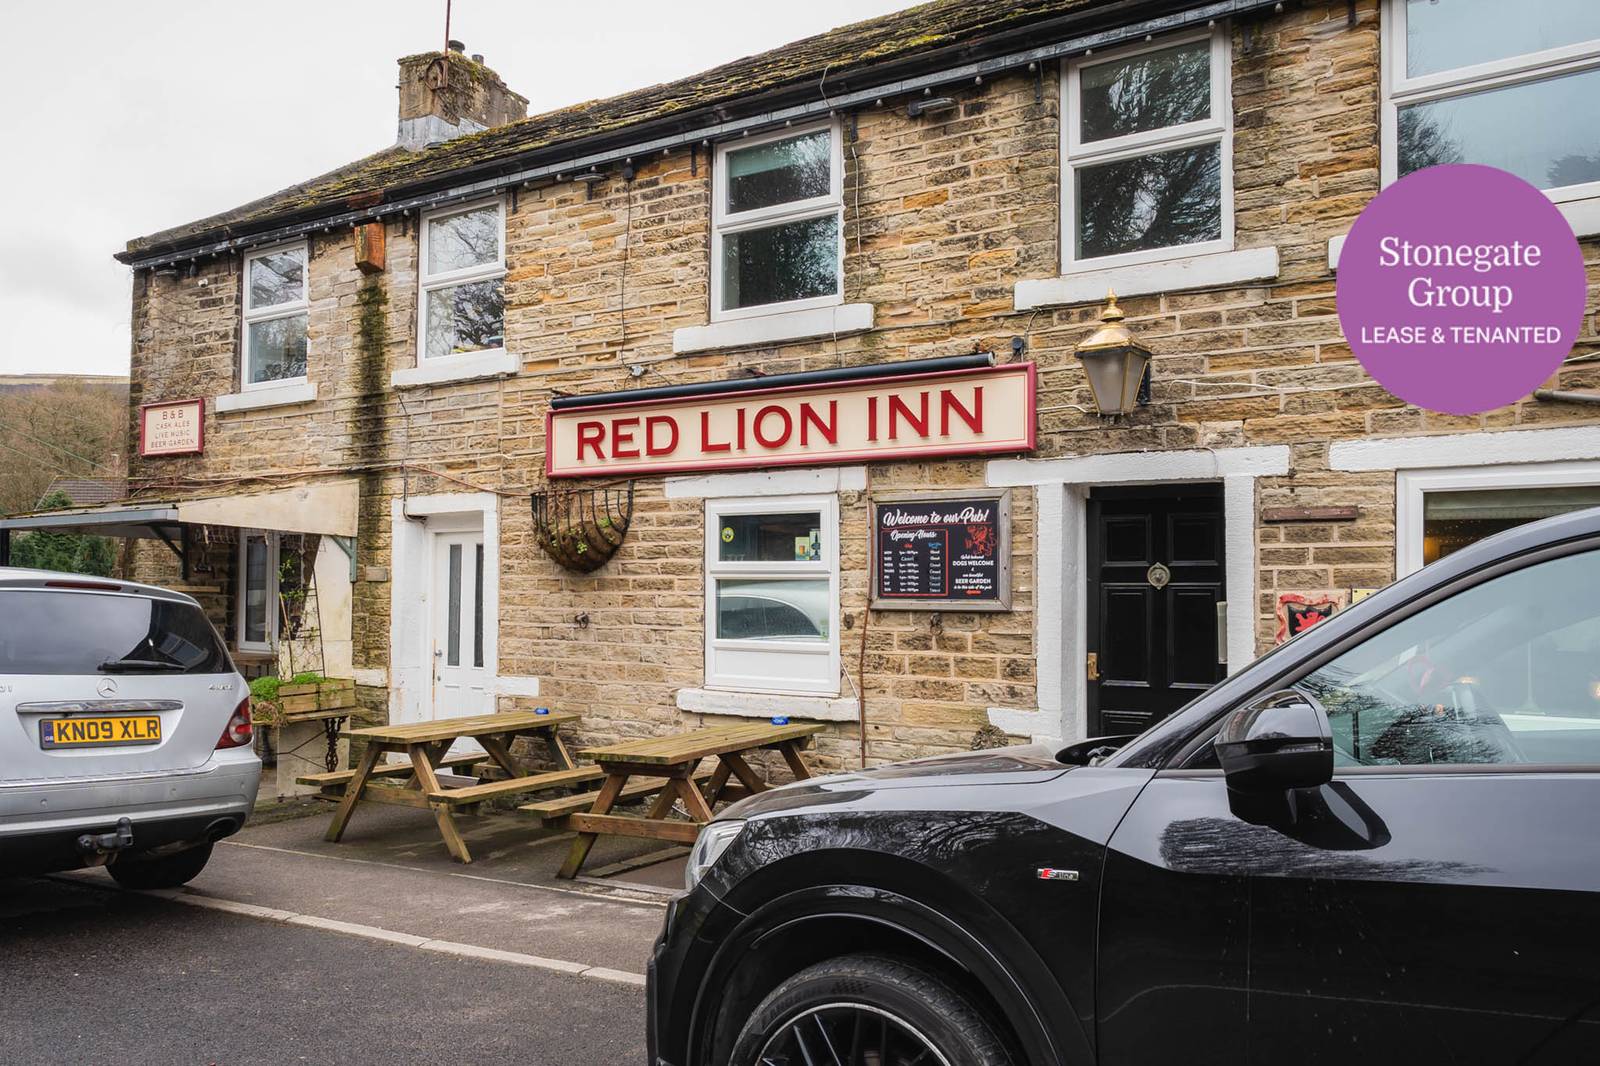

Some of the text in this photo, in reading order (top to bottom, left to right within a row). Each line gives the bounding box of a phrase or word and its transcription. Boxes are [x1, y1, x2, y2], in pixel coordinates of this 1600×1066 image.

[162, 411, 168, 420] B
[178, 409, 184, 418] B
[155, 420, 191, 430] CASK ALES
[576, 385, 984, 461] RED LION INN
[155, 431, 169, 439] LIVE
[883, 506, 990, 526] Welcome to our Pub!
[890, 529, 916, 542] Opening
[57, 719, 158, 742] KN09 XLR
